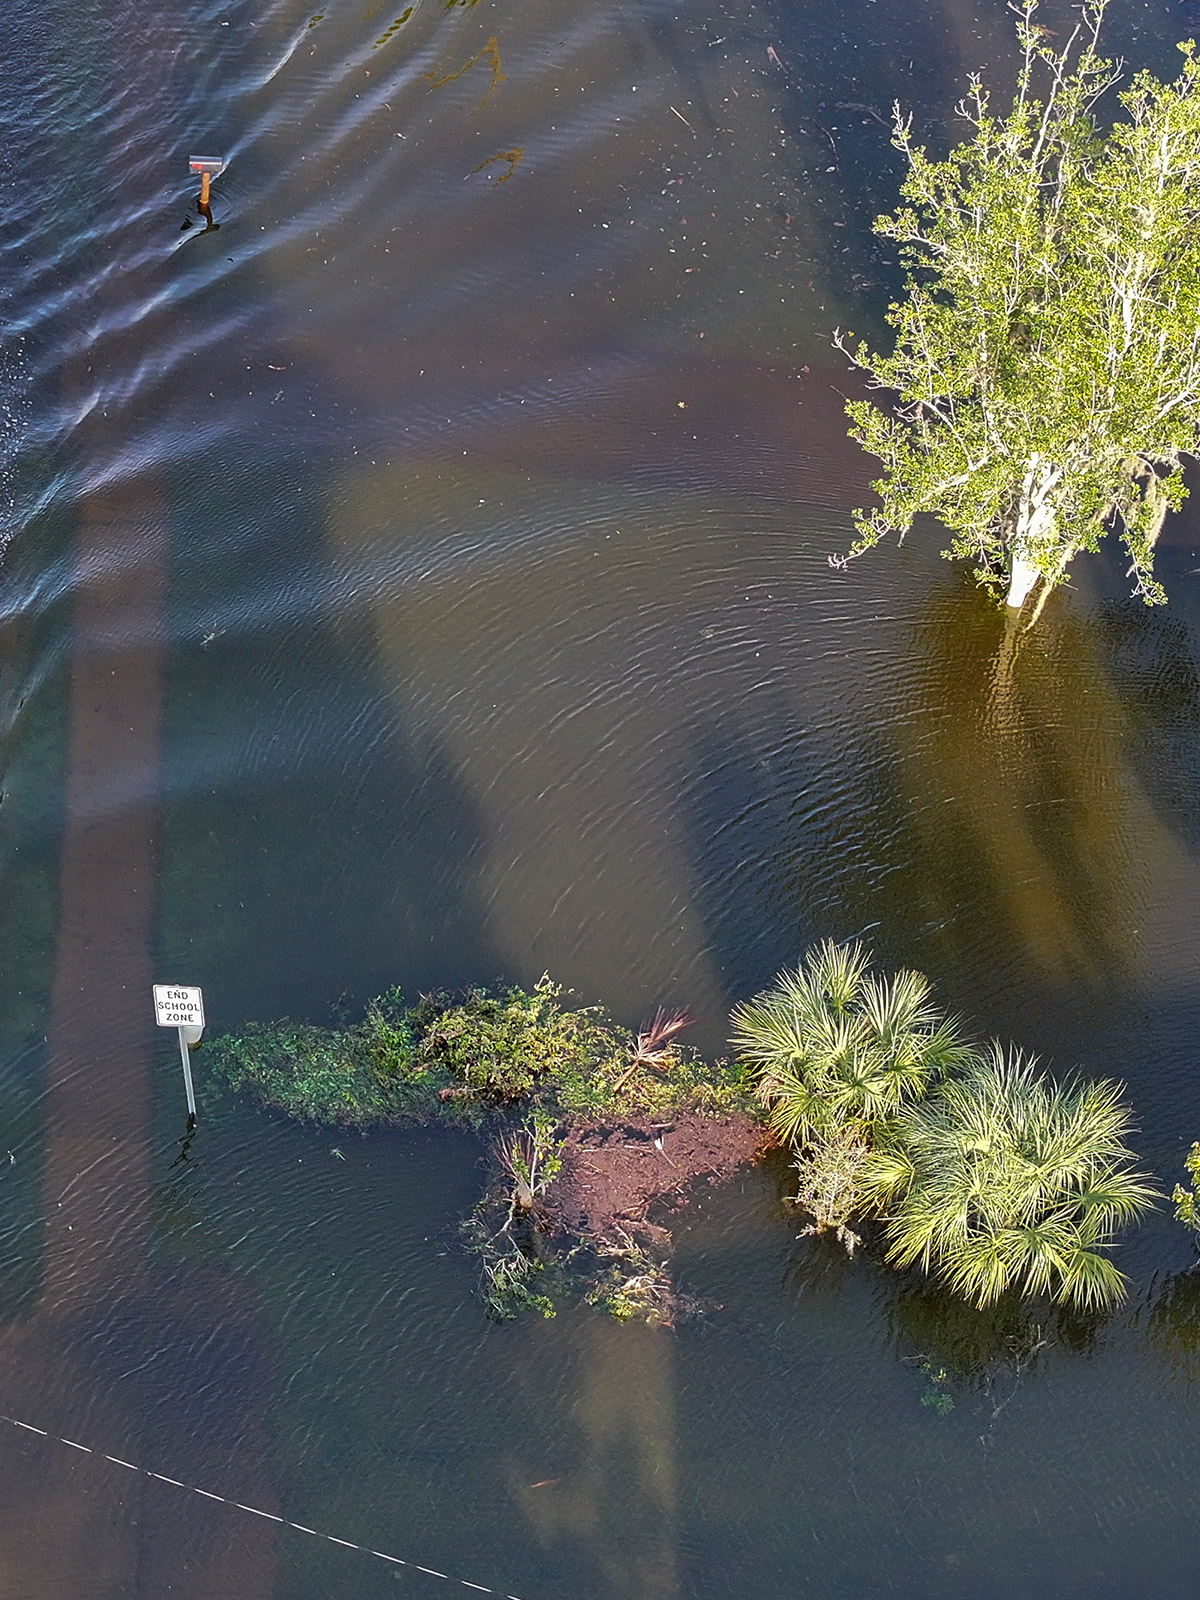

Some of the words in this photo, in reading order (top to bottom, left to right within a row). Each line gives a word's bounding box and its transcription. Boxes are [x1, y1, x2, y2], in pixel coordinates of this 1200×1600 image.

[167, 991, 189, 1000] END
[158, 1001, 200, 1011] SCHOOL
[166, 1013, 194, 1022] ZONE
